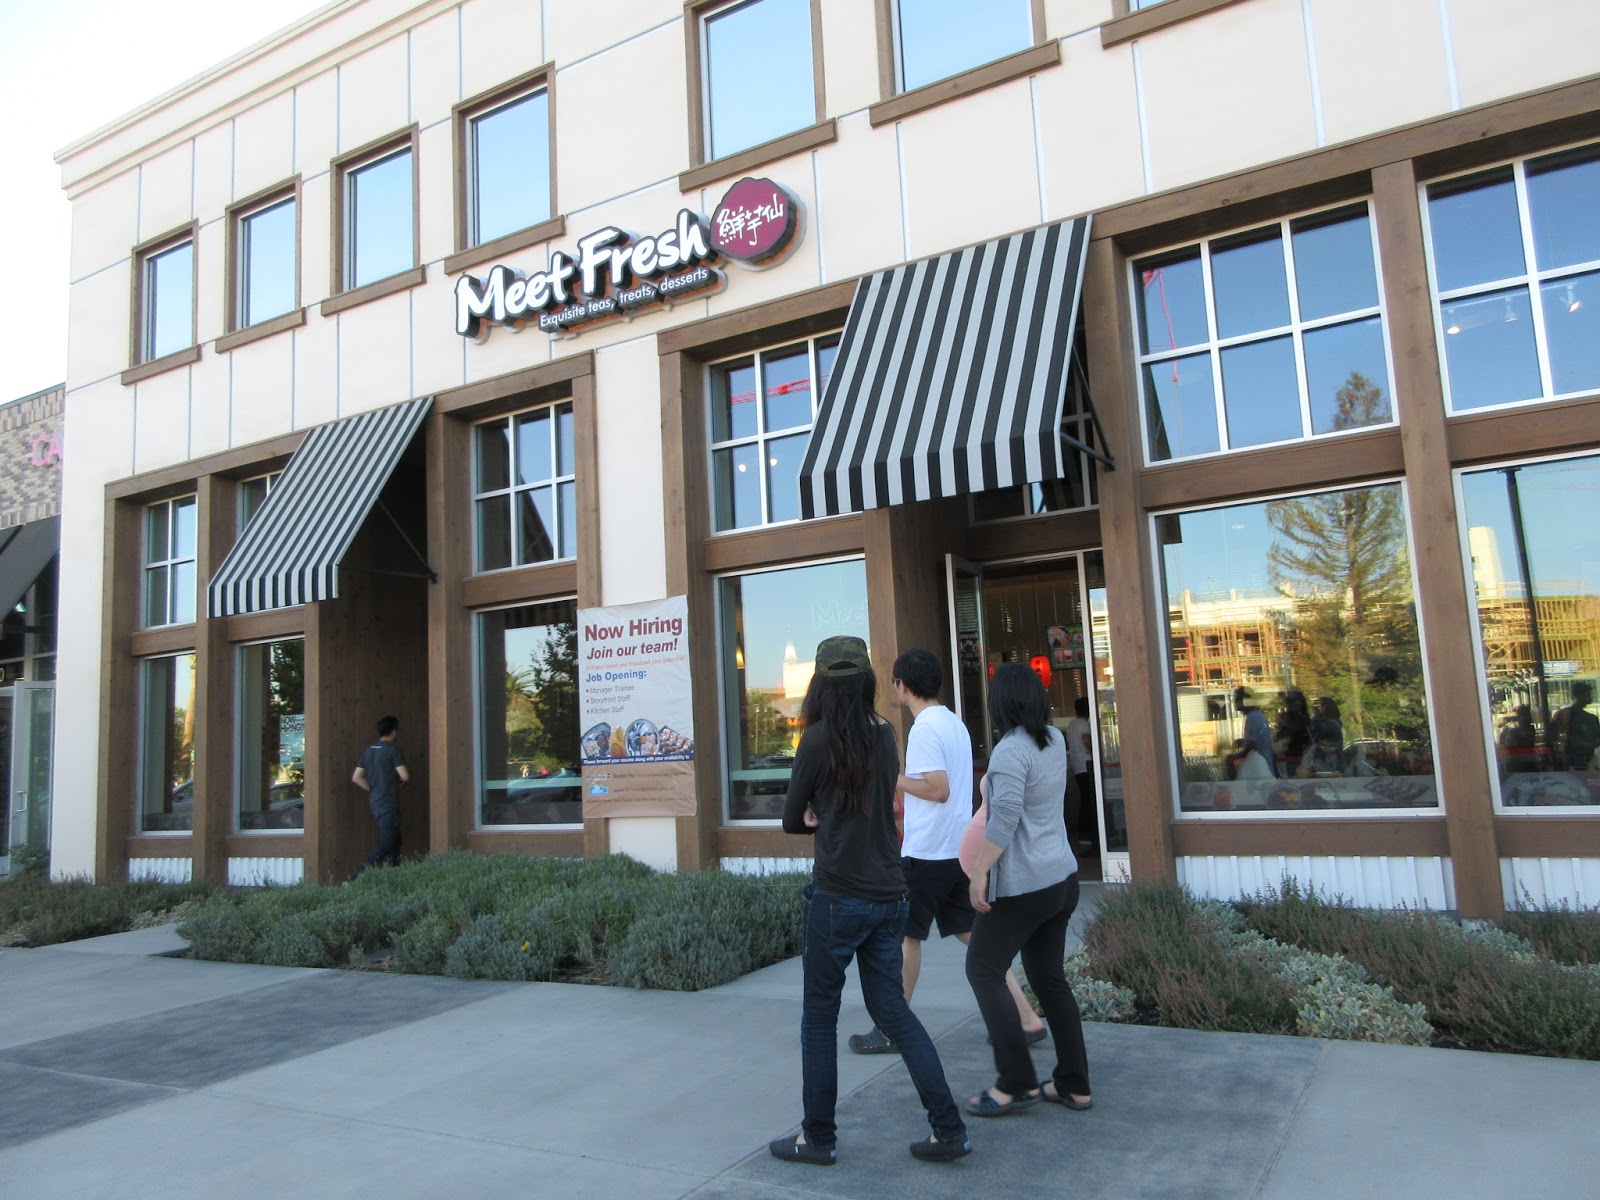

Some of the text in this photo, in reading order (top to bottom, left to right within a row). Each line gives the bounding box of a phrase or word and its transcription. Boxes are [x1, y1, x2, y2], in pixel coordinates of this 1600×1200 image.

[716, 193, 784, 246] 鮮芋仙
[456, 208, 709, 336] Meet Fresh
[539, 268, 709, 328] Exquisite teas, treats, desserts
[585, 617, 682, 641] Now Hiring
[587, 638, 677, 660] Join our team!
[586, 670, 646, 682] Job Opening:
